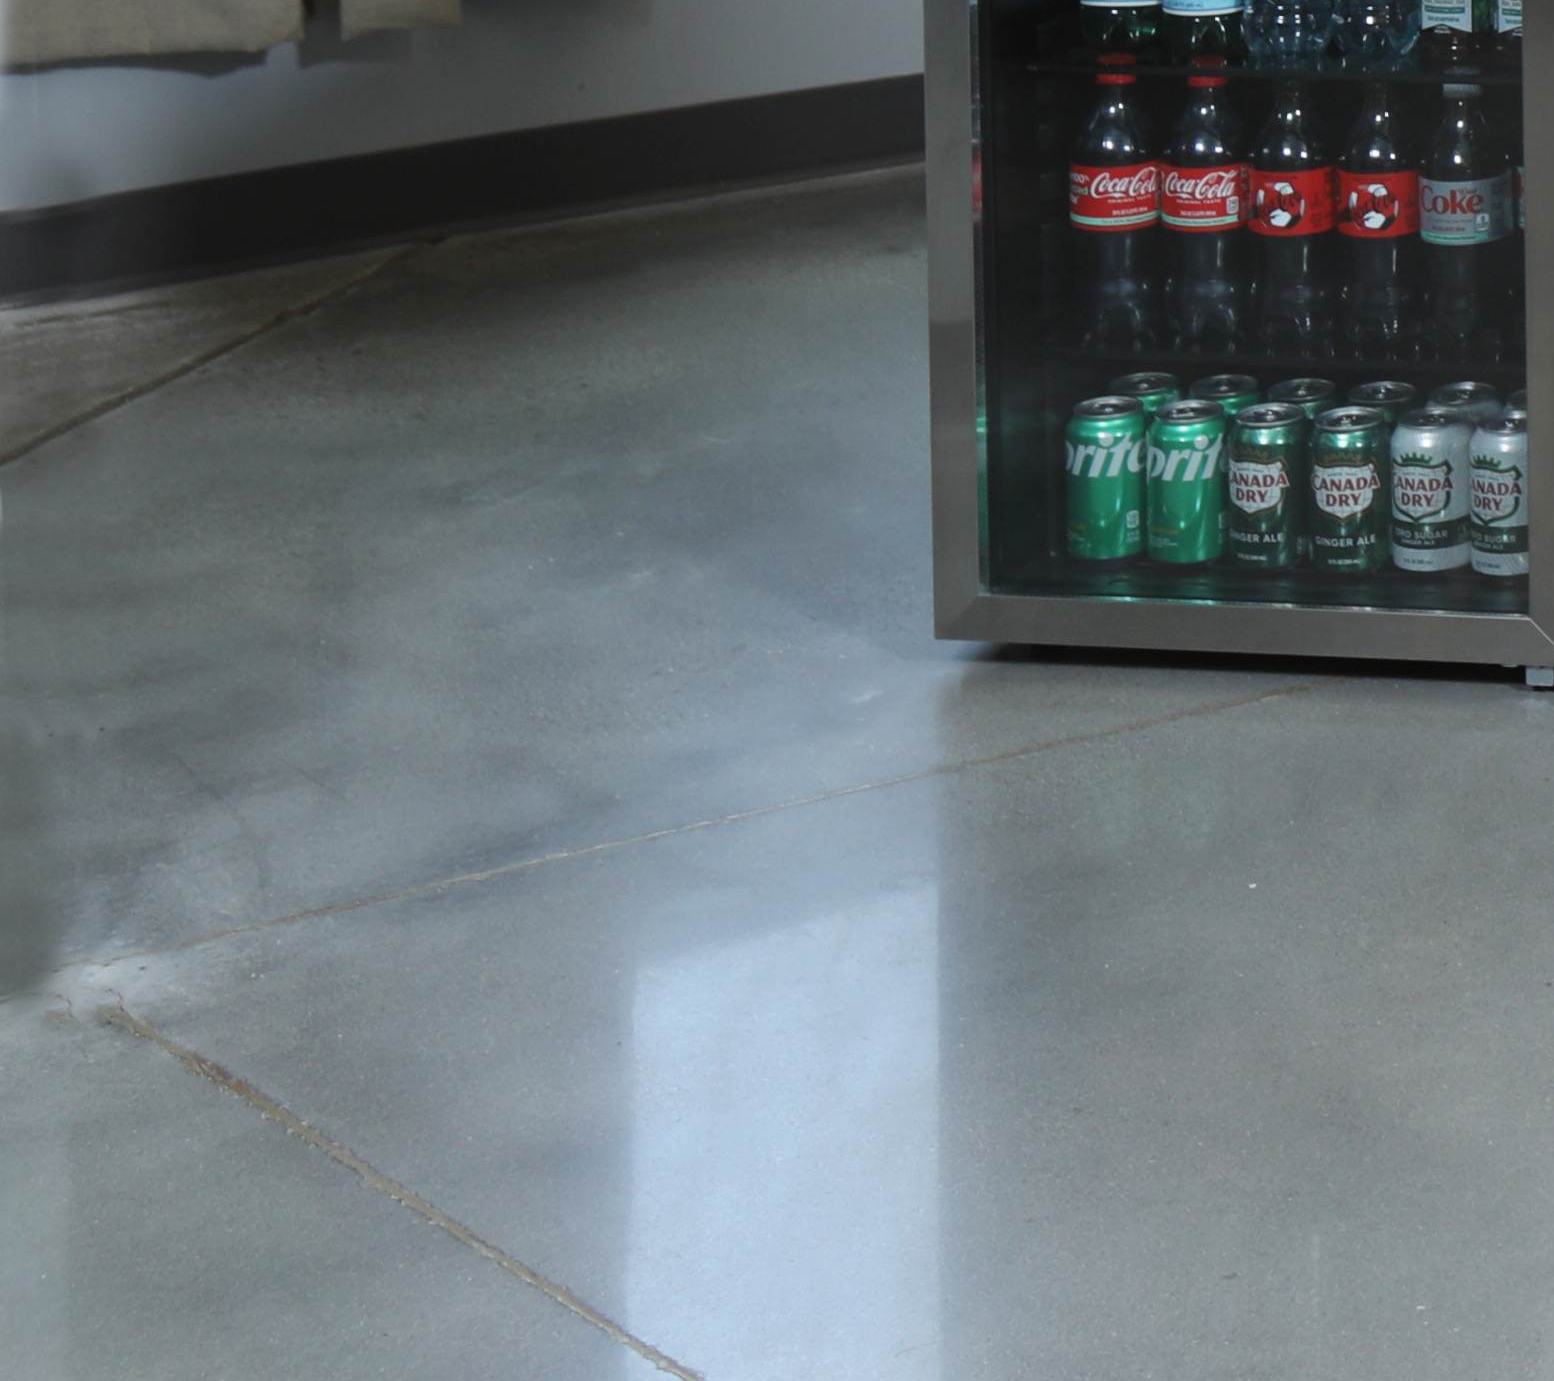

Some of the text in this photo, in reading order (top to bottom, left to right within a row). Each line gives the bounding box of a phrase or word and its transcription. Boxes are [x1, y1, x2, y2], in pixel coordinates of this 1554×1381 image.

[1090, 166, 1156, 199] Coca-Col
[1165, 170, 1238, 200] Coca-Cola
[1421, 184, 1485, 215] Coke
[1313, 473, 1382, 491] CANADA
[1235, 489, 1269, 503] DRY
[1325, 492, 1363, 507] DRY
[1400, 493, 1435, 508] DRY
[1473, 496, 1504, 512] DRY
[1262, 532, 1285, 543] ALE
[1315, 534, 1376, 548] GINGER ALE
